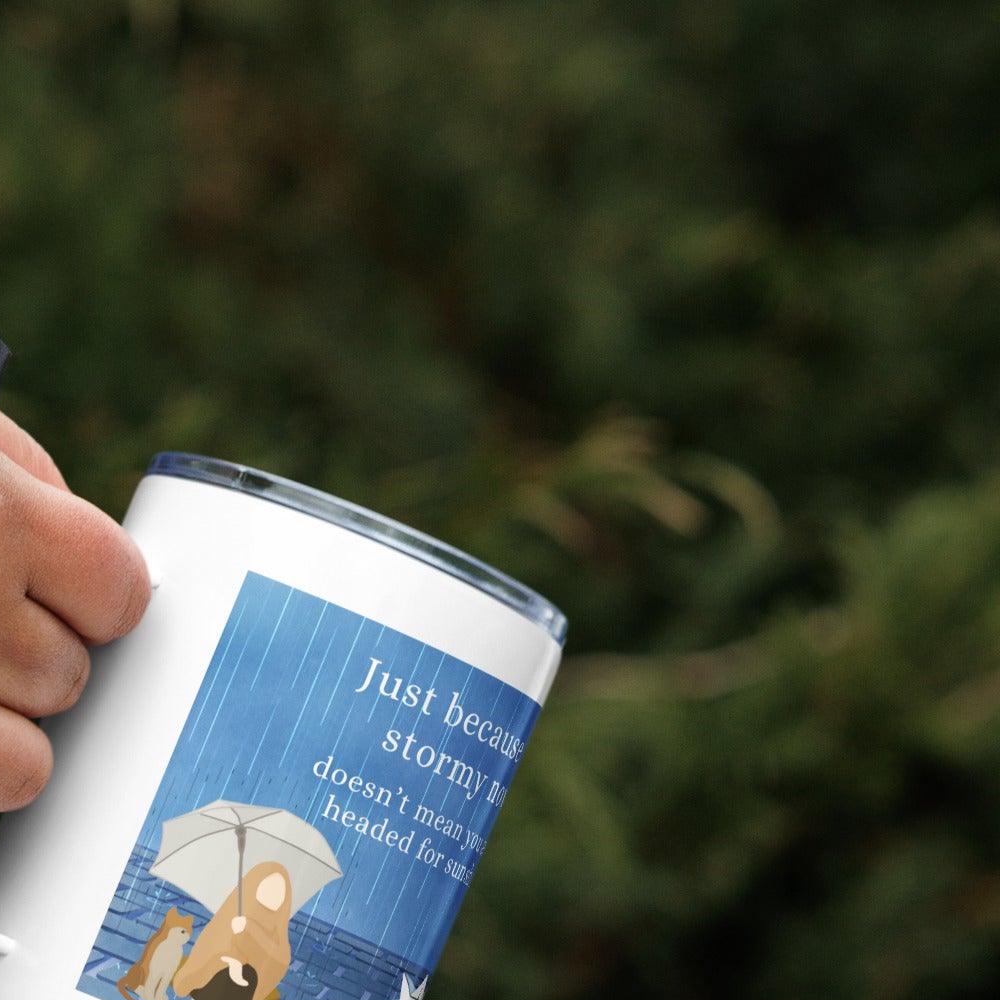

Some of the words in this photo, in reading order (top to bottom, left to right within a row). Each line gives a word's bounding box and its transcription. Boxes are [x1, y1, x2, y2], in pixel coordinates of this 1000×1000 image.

[355, 657, 437, 715] Just
[443, 691, 525, 763] because
[312, 755, 410, 815] doesn't
[413, 801, 463, 841] mean
[382, 729, 489, 800] stormy
[320, 794, 416, 854] headed
[416, 838, 445, 868] for
